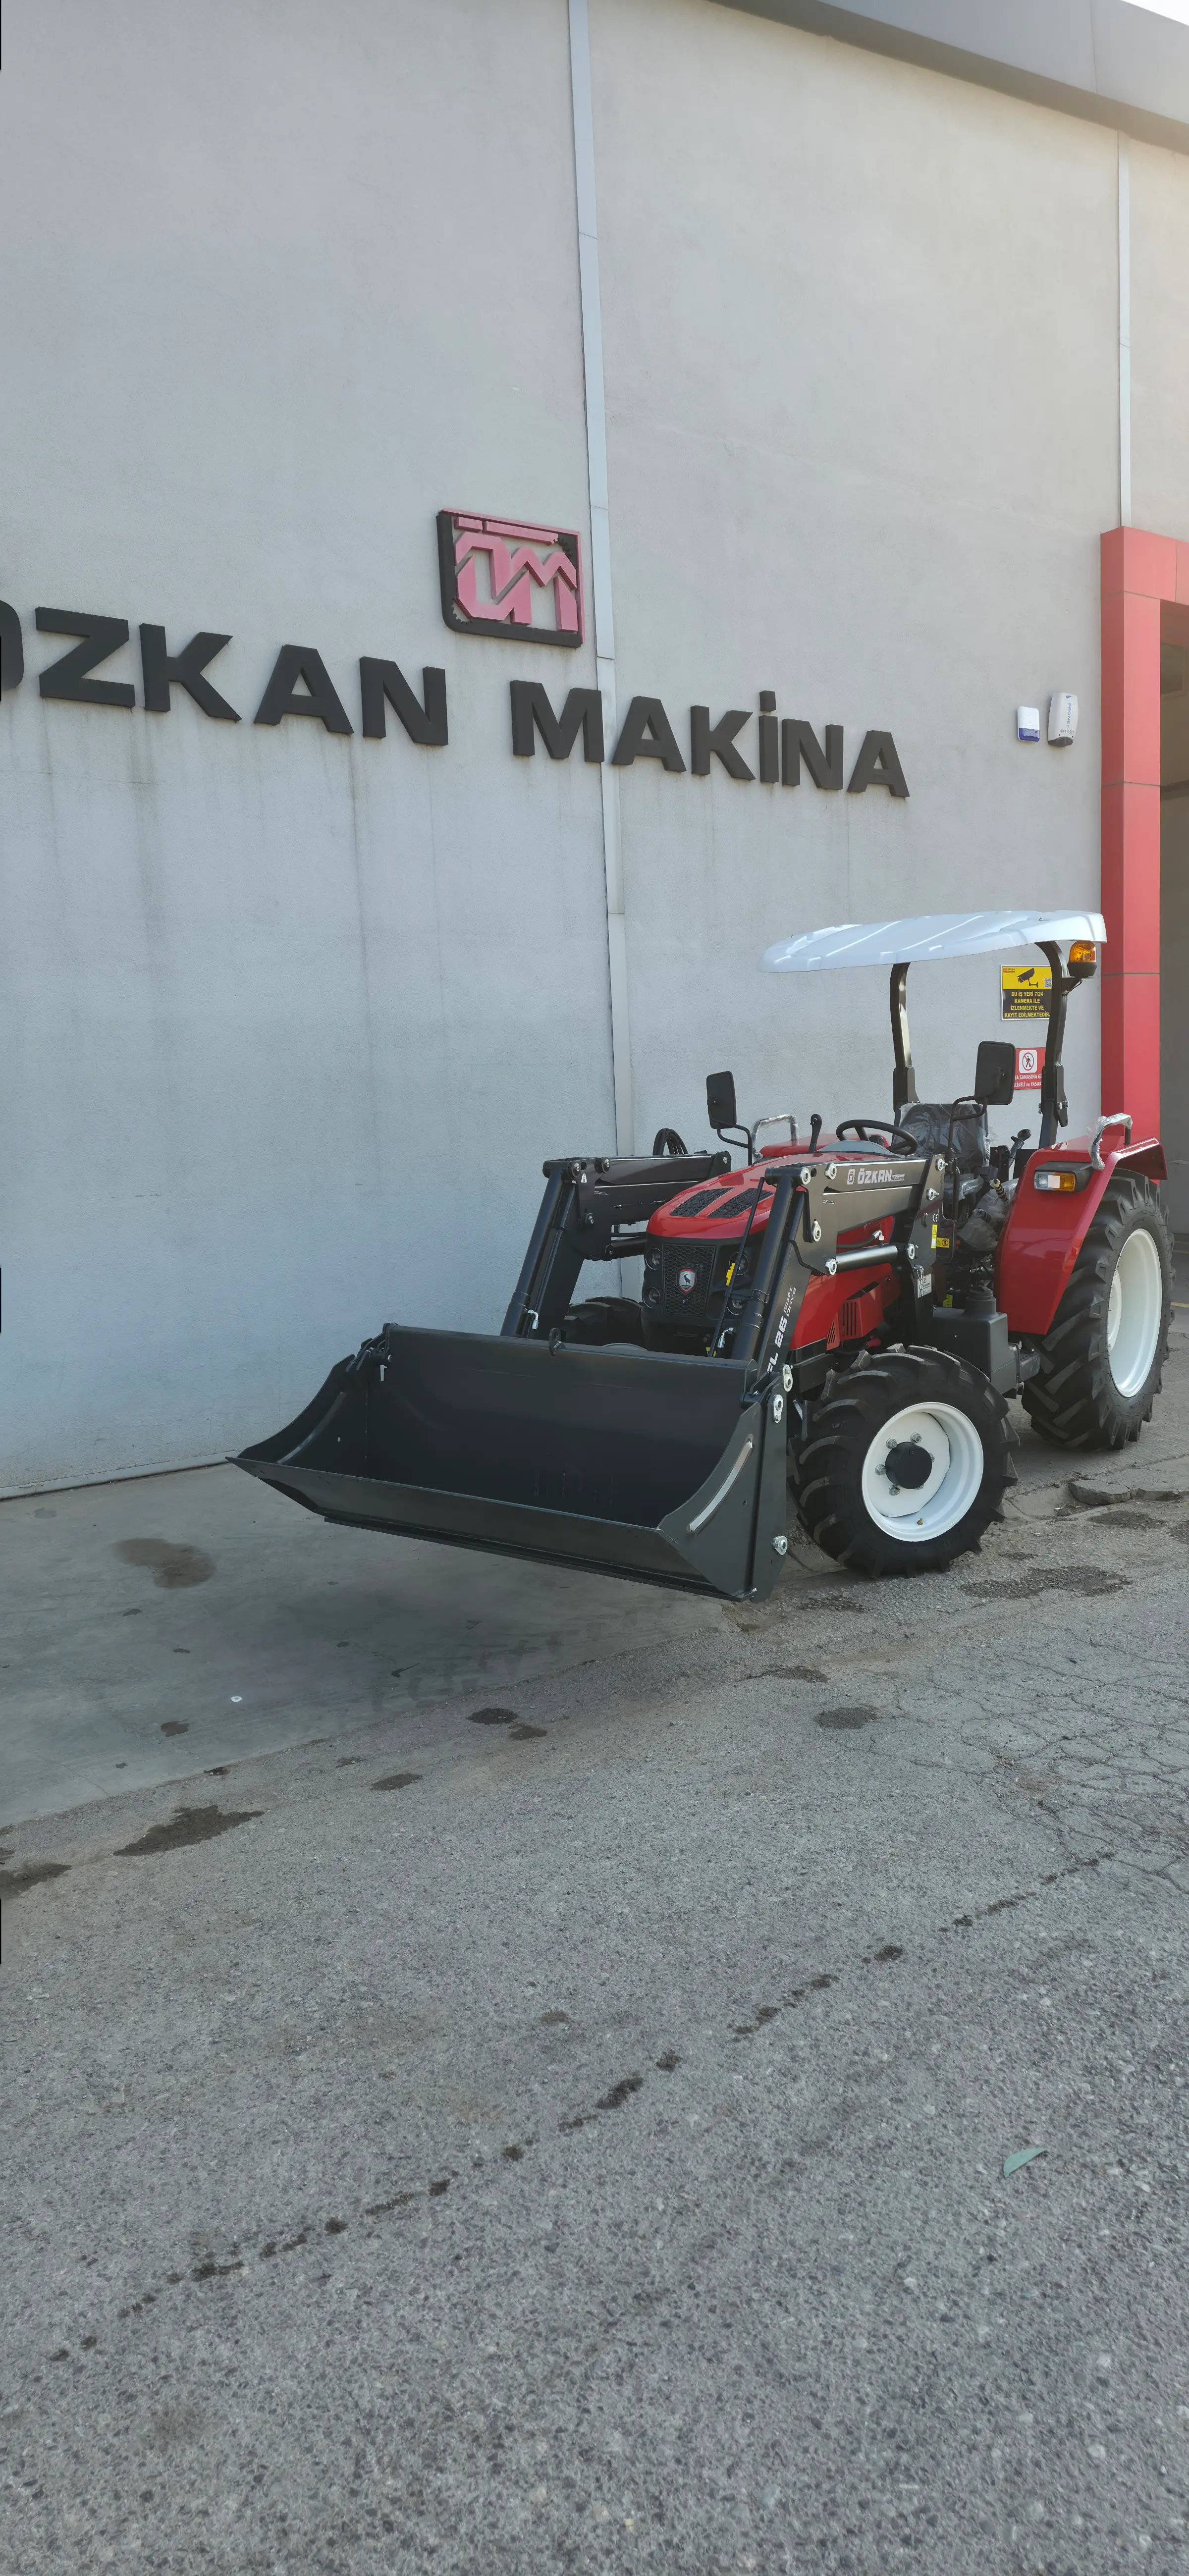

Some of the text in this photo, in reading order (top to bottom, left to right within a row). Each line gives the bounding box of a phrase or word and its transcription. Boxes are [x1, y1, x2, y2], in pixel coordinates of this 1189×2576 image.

[0, 600, 910, 798] ZKAN MAKİNA
[858, 1168, 892, 1184] ÖZKAN
[775, 1316, 787, 1348] 26
